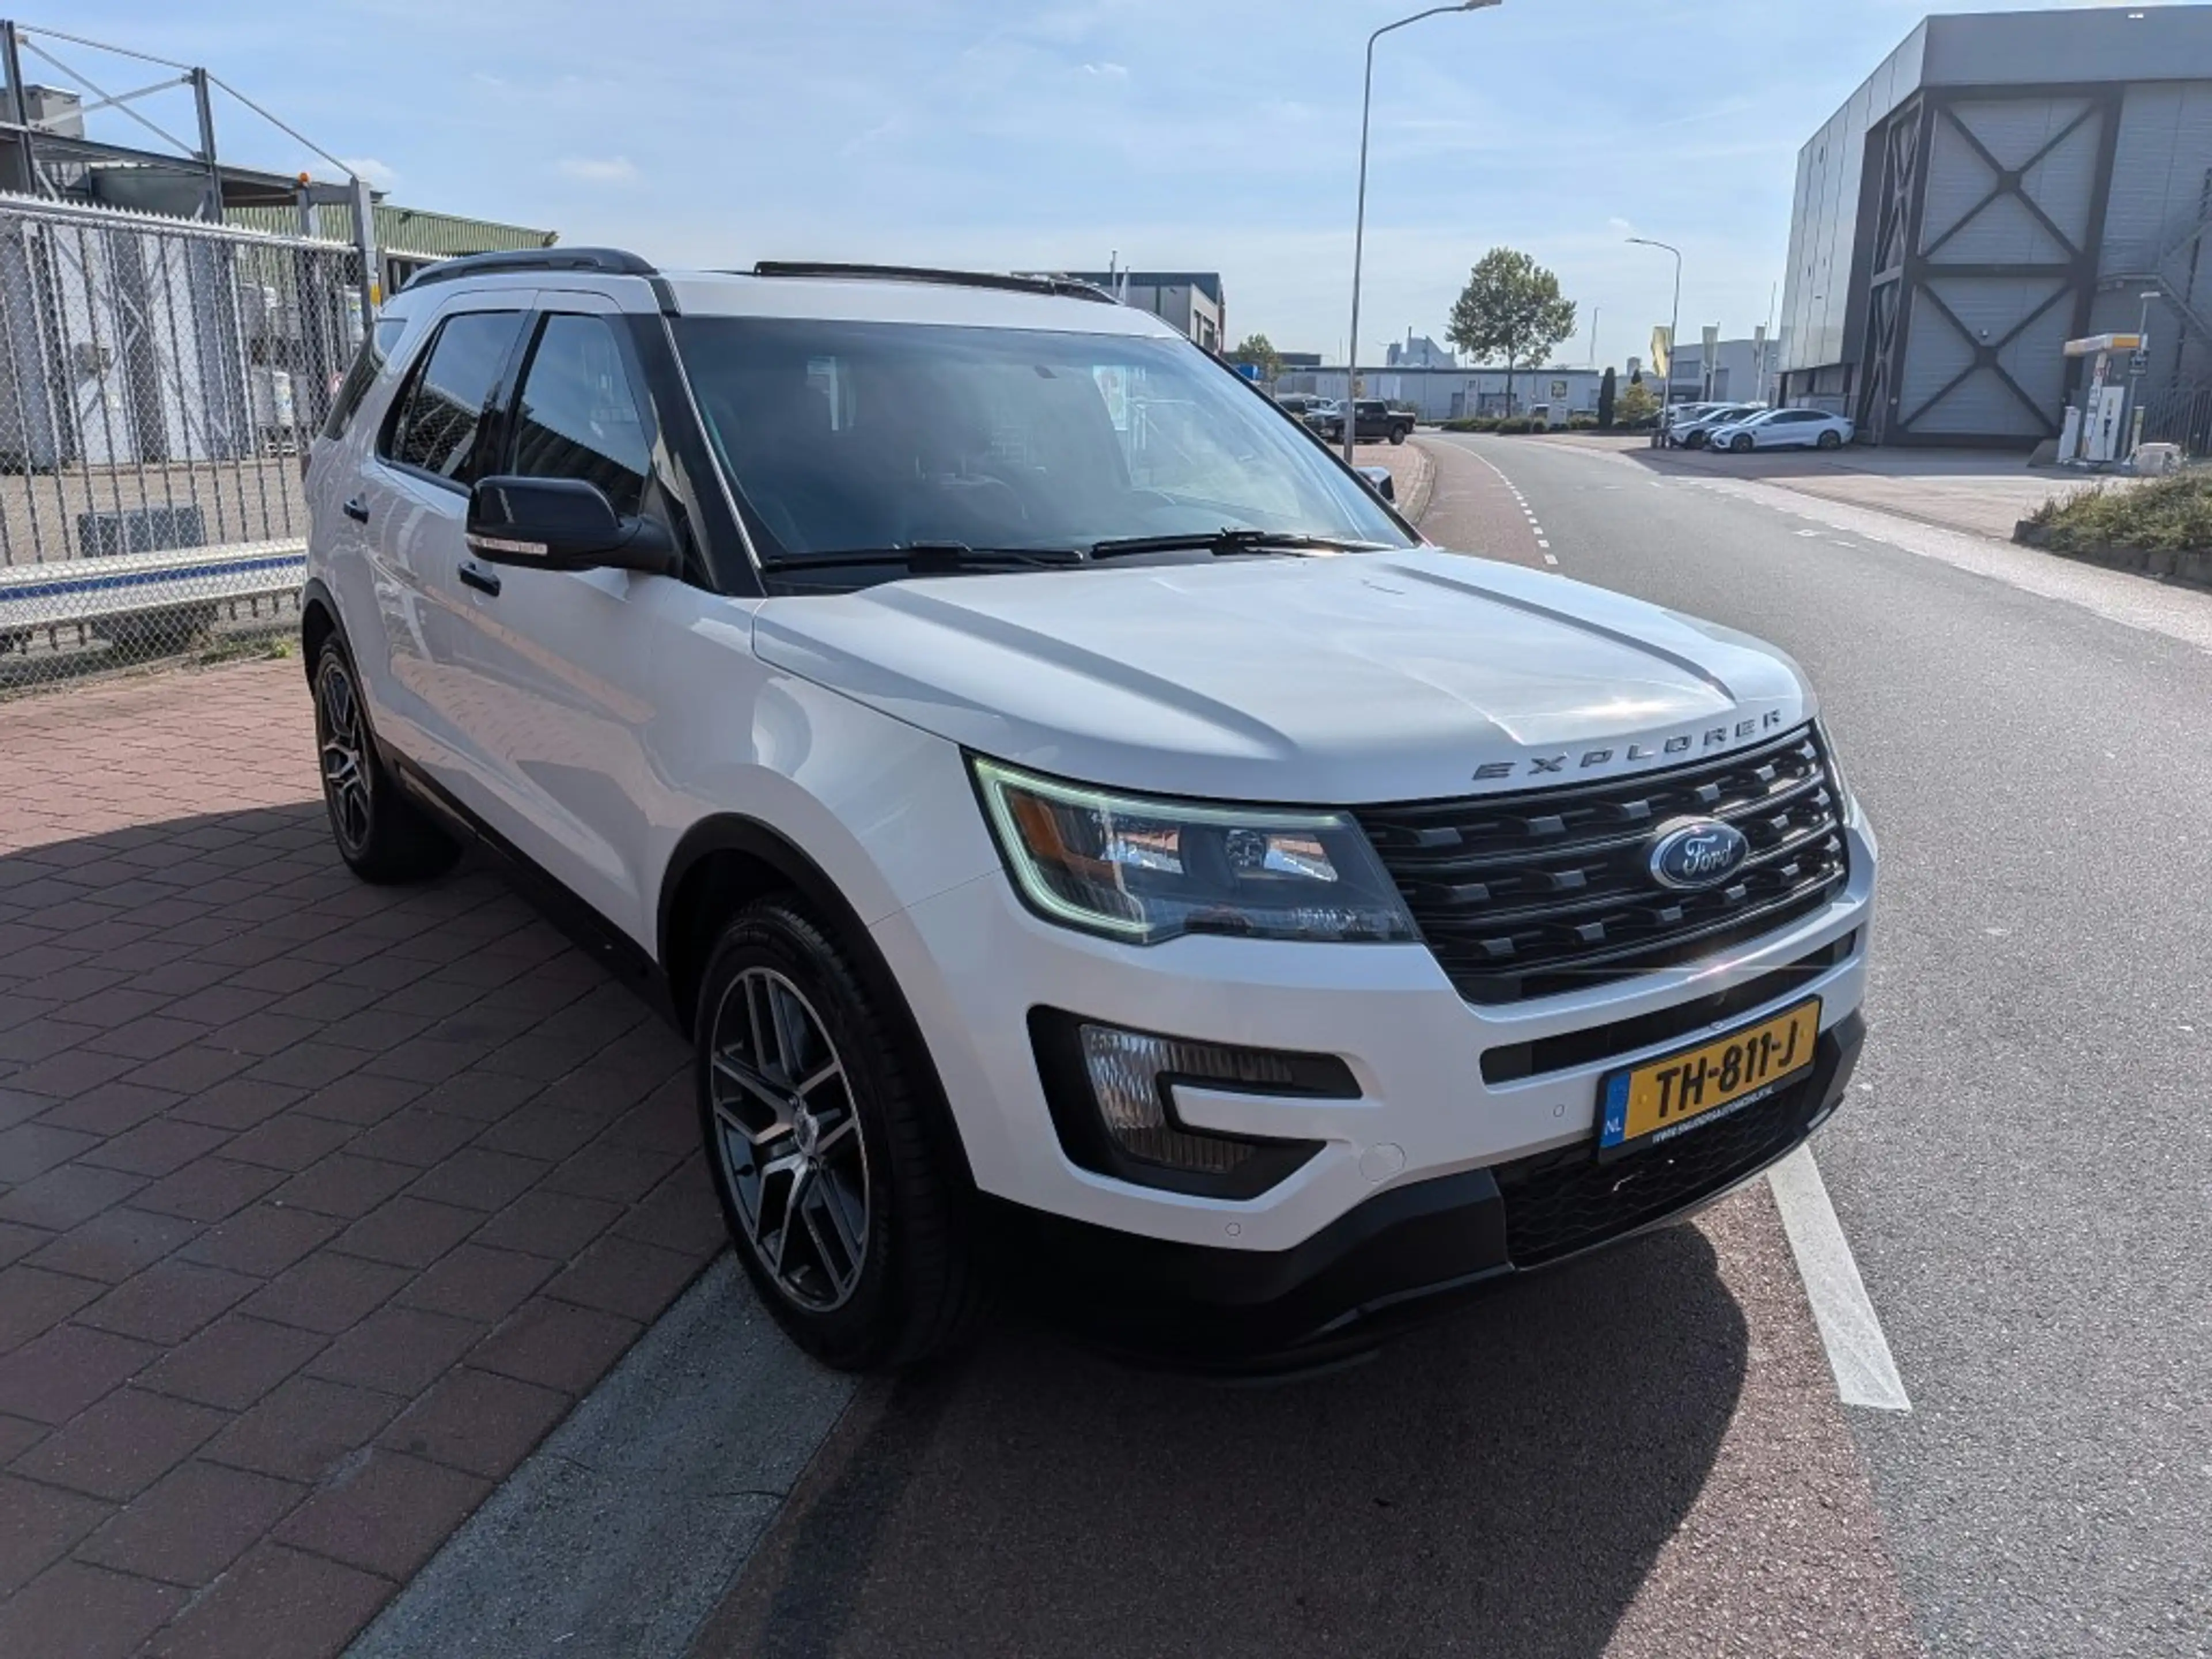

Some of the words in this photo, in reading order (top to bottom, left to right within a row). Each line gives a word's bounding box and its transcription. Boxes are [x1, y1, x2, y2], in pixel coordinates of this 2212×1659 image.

[1472, 709, 1781, 779] EXPLORER
[1682, 834, 1736, 877] Ford
[1656, 1020, 1798, 1118] TH-811-J
[1604, 1116, 1622, 1135] NL
